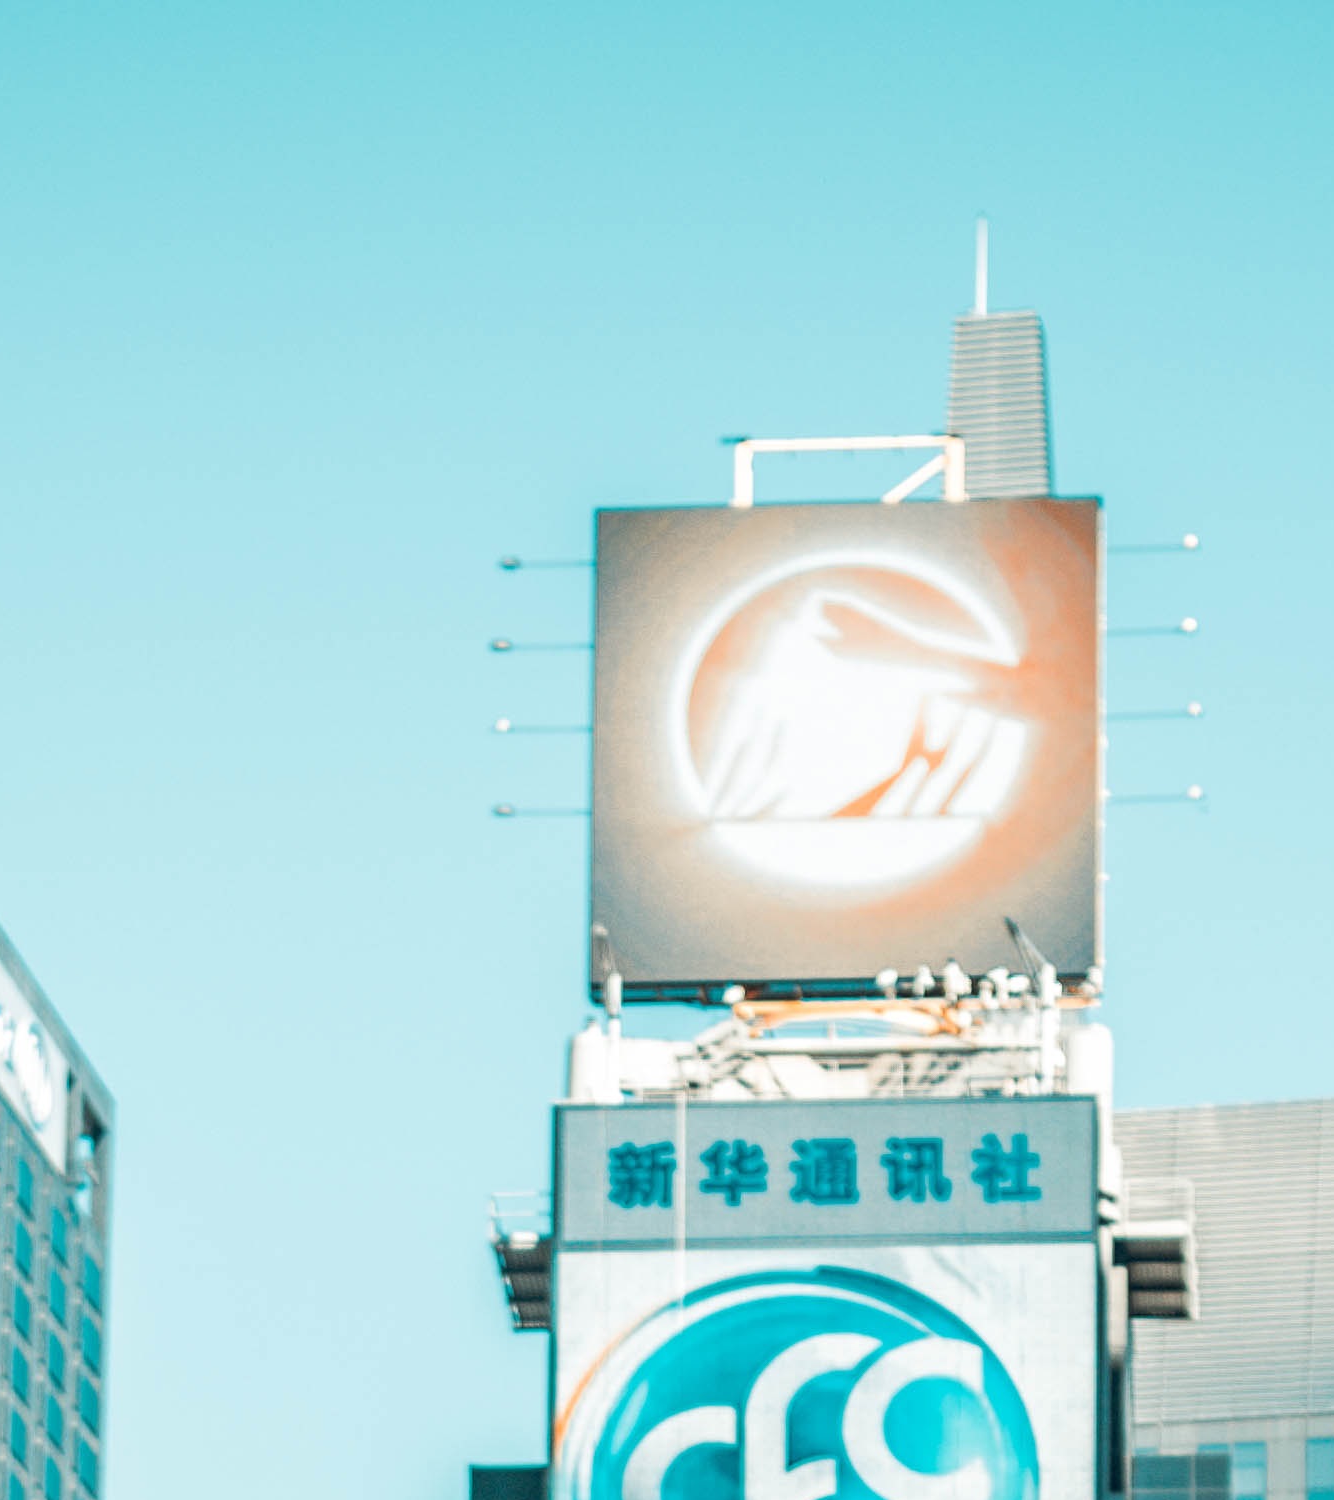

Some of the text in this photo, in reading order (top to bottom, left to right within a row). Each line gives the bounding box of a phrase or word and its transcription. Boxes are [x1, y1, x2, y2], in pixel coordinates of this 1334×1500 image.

[608, 1133, 1042, 1209] 新华通讯社
